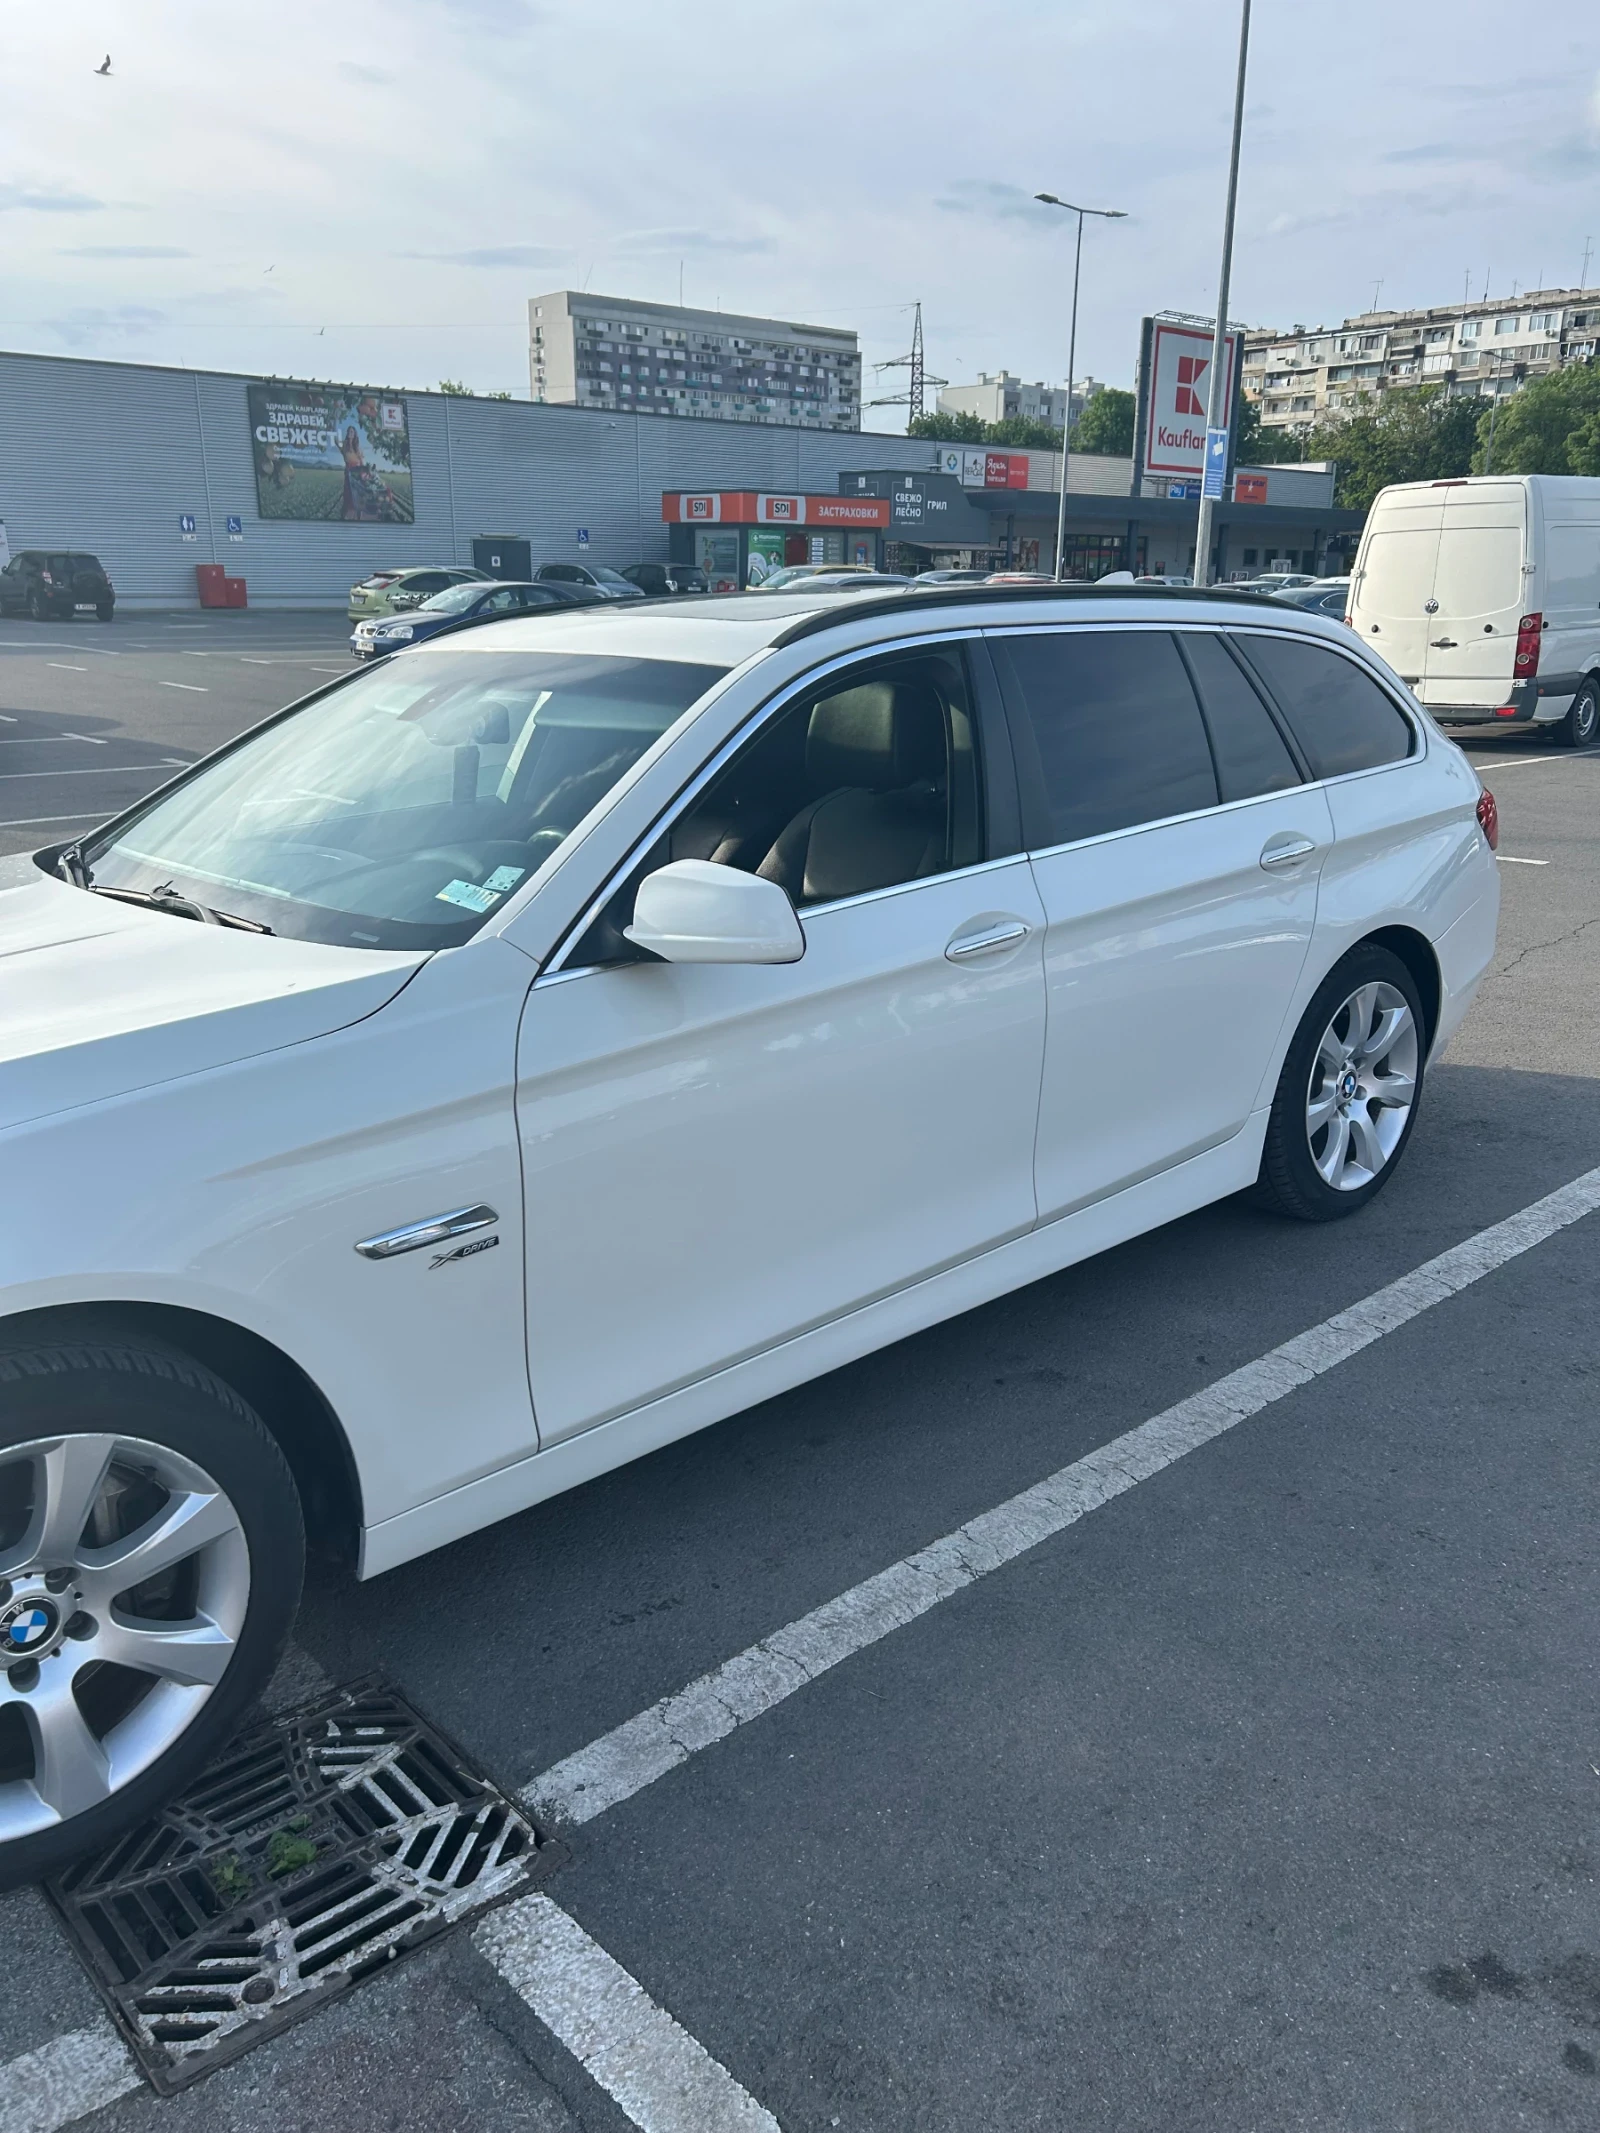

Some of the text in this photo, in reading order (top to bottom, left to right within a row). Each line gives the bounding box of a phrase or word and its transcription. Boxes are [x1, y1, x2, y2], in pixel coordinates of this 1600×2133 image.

[269, 412, 327, 428] ЗДРАВЕЙ,
[256, 426, 343, 447] СВЕЖЕСТ!
[1158, 426, 1206, 450] Kauflan
[895, 493, 922, 503] СВЕЖО
[693, 501, 706, 512] SDI
[774, 502, 789, 513] SDI
[927, 500, 947, 511] ГРИЛ
[819, 506, 878, 519] ЗАСТРАХОВКИ
[895, 507, 921, 517] ЛЕСНО
